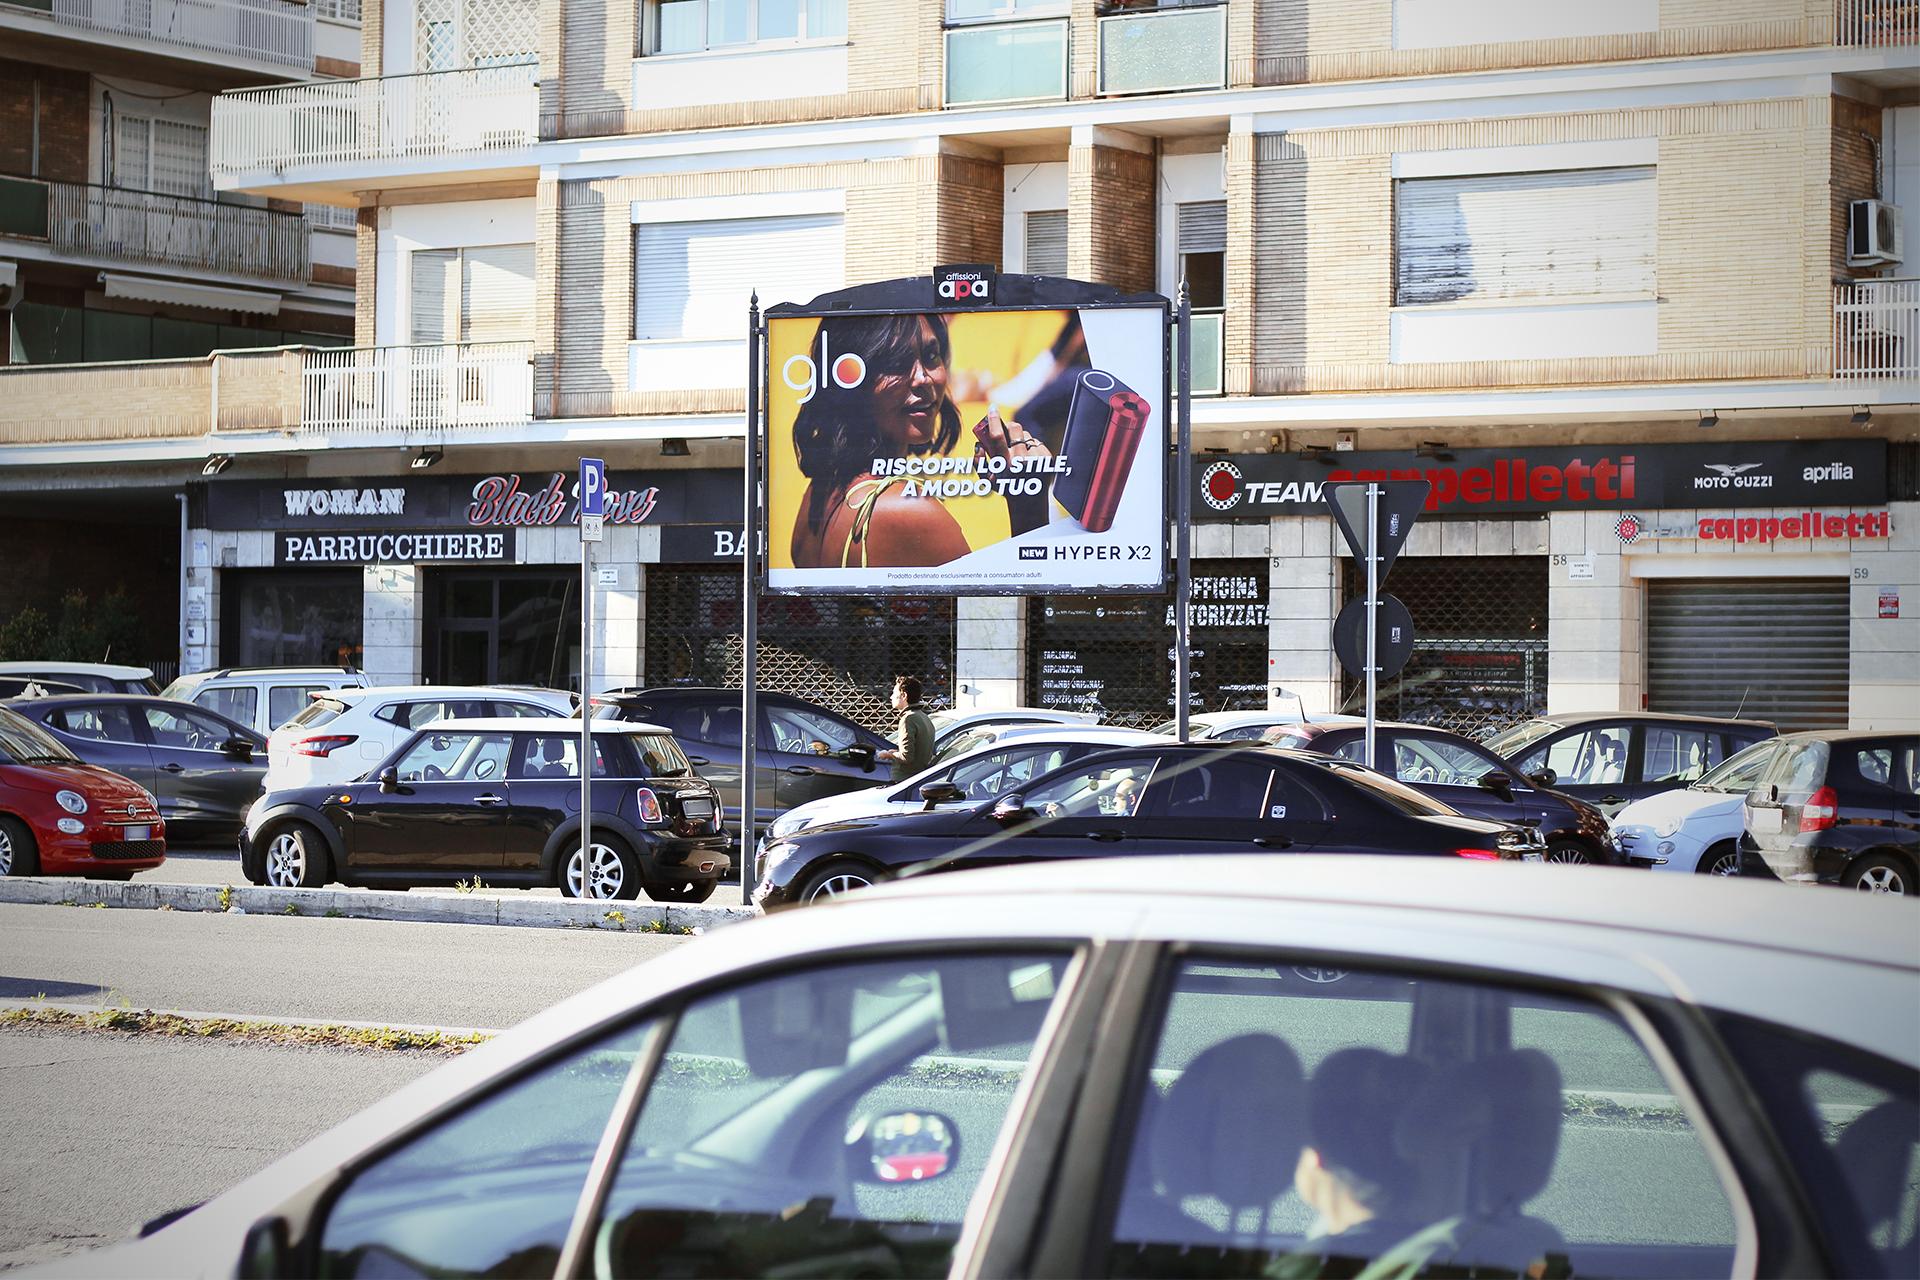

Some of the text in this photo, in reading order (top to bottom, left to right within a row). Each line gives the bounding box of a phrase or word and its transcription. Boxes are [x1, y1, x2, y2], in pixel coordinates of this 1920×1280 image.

[946, 272, 981, 281] affissioni
[938, 279, 989, 301] apa
[782, 330, 867, 405] glo
[871, 455, 1073, 477] RISCOPRI LO STILE,
[1803, 462, 1854, 484] aprilia
[585, 465, 600, 509] P
[900, 477, 1043, 497] A MODO TUO
[1245, 481, 1328, 504] TEAM
[1327, 455, 1636, 511] pelletti
[1694, 476, 1773, 489] MOTO GUZZI
[283, 488, 406, 516] WOMAN
[463, 472, 660, 526] Black ose
[1697, 511, 1889, 544] cappelletti
[285, 533, 504, 562] PARRUCCHIERE
[1021, 545, 1152, 560] NEW HYPER X2
[1553, 554, 1567, 566] 58
[1854, 567, 1869, 579] 59
[1165, 604, 1269, 626] ATORIZZATA
